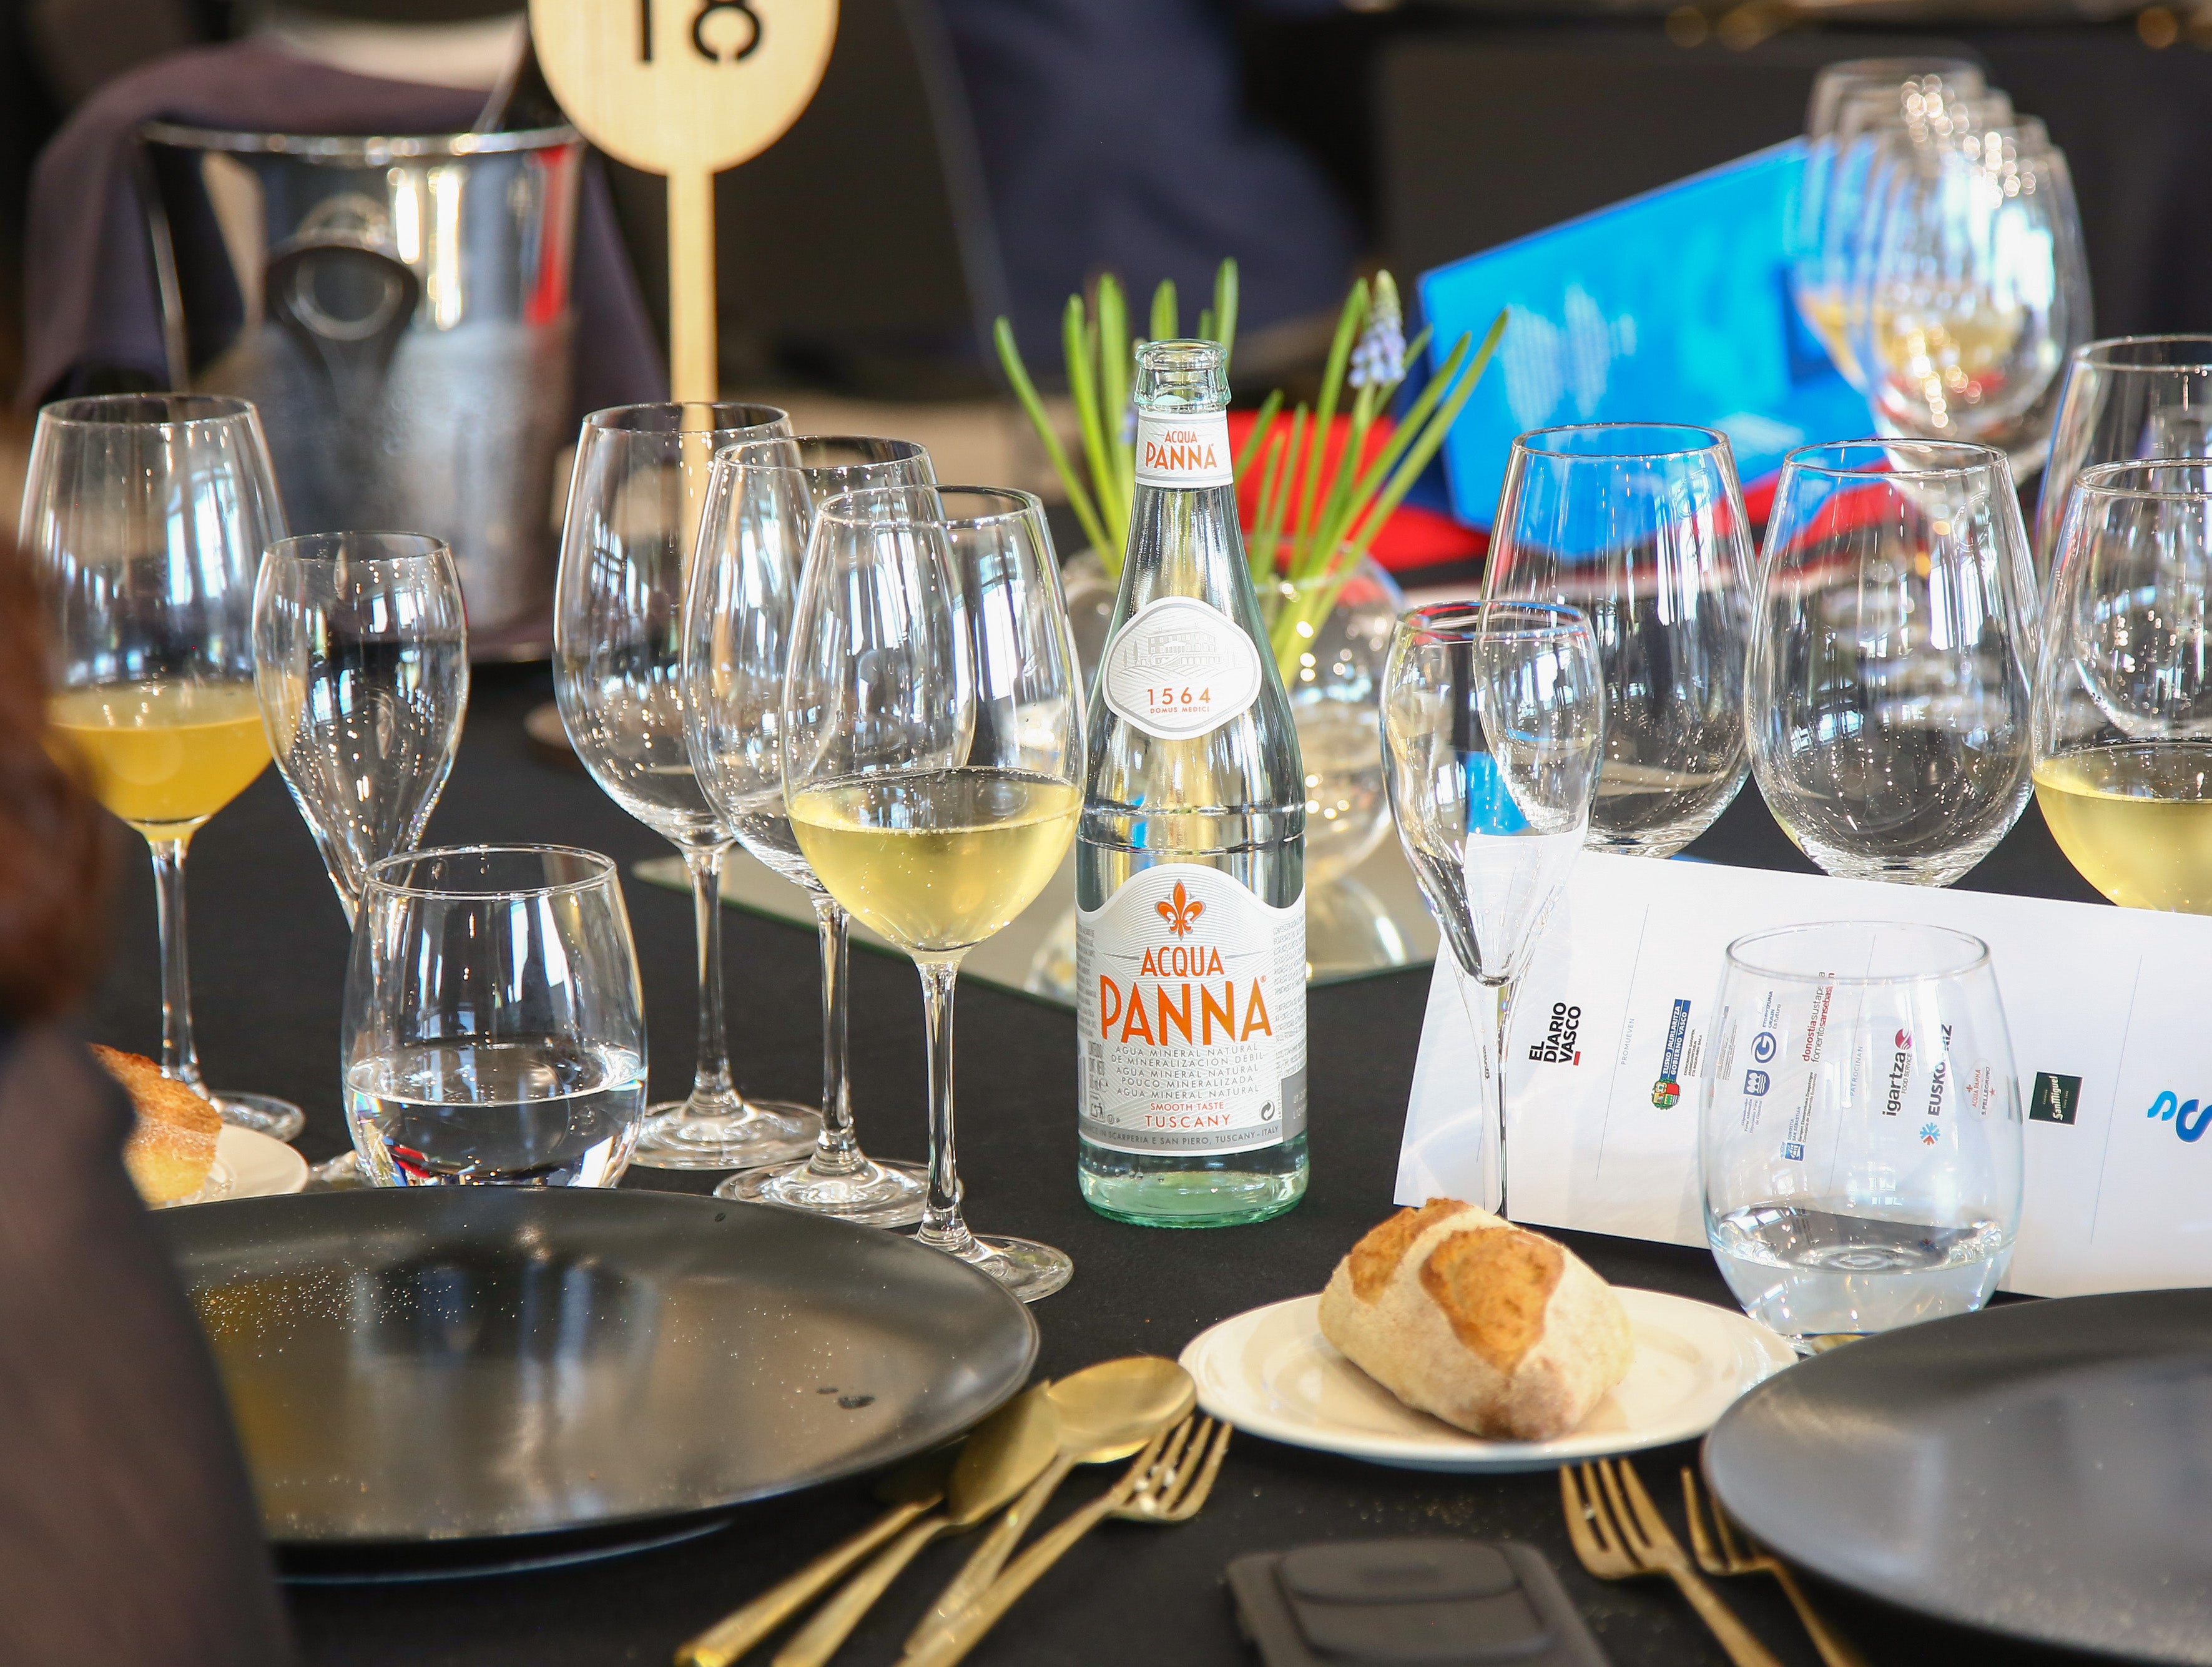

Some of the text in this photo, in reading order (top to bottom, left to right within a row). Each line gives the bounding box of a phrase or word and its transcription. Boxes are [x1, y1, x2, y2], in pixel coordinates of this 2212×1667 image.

[1164, 430, 1198, 444] ACQUA
[1145, 441, 1216, 471] PANNA
[1147, 687, 1211, 706] 1564
[1140, 946, 1224, 978] ACQUA
[1099, 974, 1272, 1046] PANNA
[1544, 1003, 1566, 1063] DIARIO
[1558, 1005, 1581, 1063] VASCO
[1621, 1018, 1635, 1065] PROMUEVEN
[1663, 1006, 1681, 1074] EUSKO JAURLARITZA
[1671, 1011, 1688, 1075] GOBIERNO VASCO
[1111, 1052, 1264, 1068] DE MINERALIZACIÓN DÉBIL
[1115, 1043, 1258, 1058] AGUA MINERAL NATURAL
[1529, 1041, 1543, 1061] EL
[1116, 1064, 1259, 1079] AGUA MINERAL NATURAL
[1850, 1046, 1862, 1096] PATROCINAN
[1904, 1053, 1912, 1077] SERVICE
[1117, 1088, 1145, 1098] AGUA
[1209, 1085, 1259, 1098] NATURAL
[1121, 1075, 1254, 1089] POUCO MINERALIZADA
[1883, 1052, 1907, 1116] igartza
[1150, 1102, 1224, 1111] SMOOTH TASTE
[1144, 1114, 1231, 1128] TUSCANY
[1108, 1131, 1148, 1144] SCARPERIA
[1160, 1137, 1179, 1145] SAN
[1182, 1137, 1211, 1145] PIERO,
[1261, 1126, 1279, 1137] ITALY
